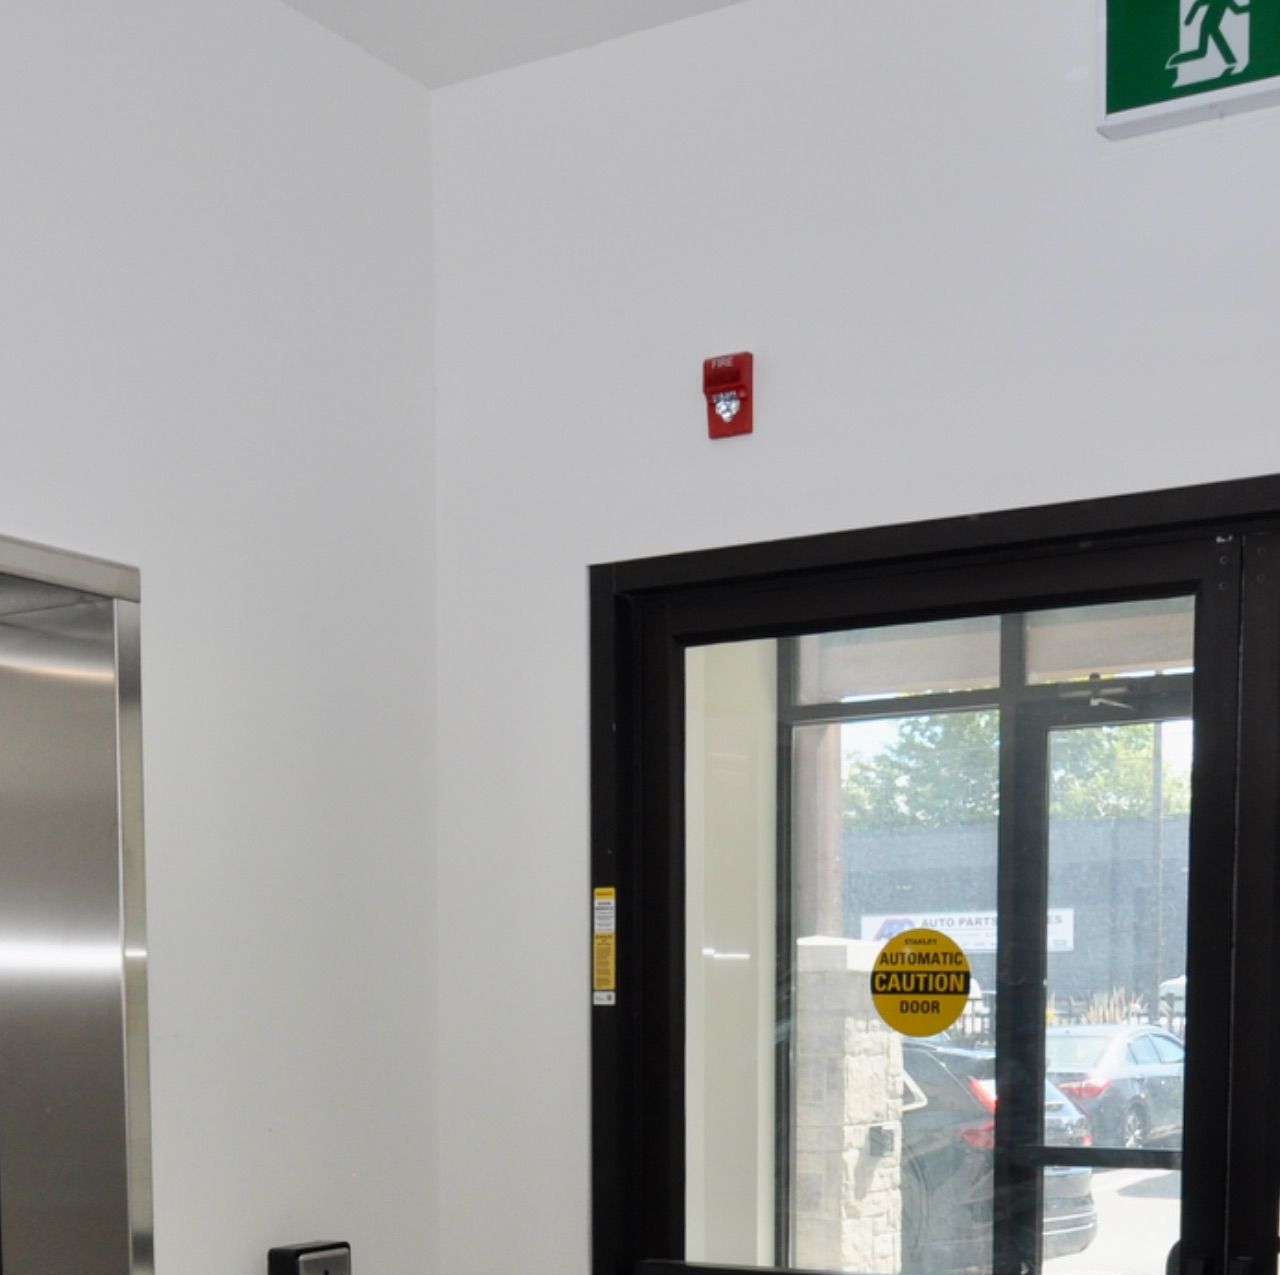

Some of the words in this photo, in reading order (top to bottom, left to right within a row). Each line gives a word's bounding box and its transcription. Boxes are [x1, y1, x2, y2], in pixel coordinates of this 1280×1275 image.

[921, 918, 955, 928] AUTO
[880, 952, 963, 966] AUTOMATIC
[874, 973, 966, 992] CAUTION
[899, 1000, 940, 1014] DOOR
